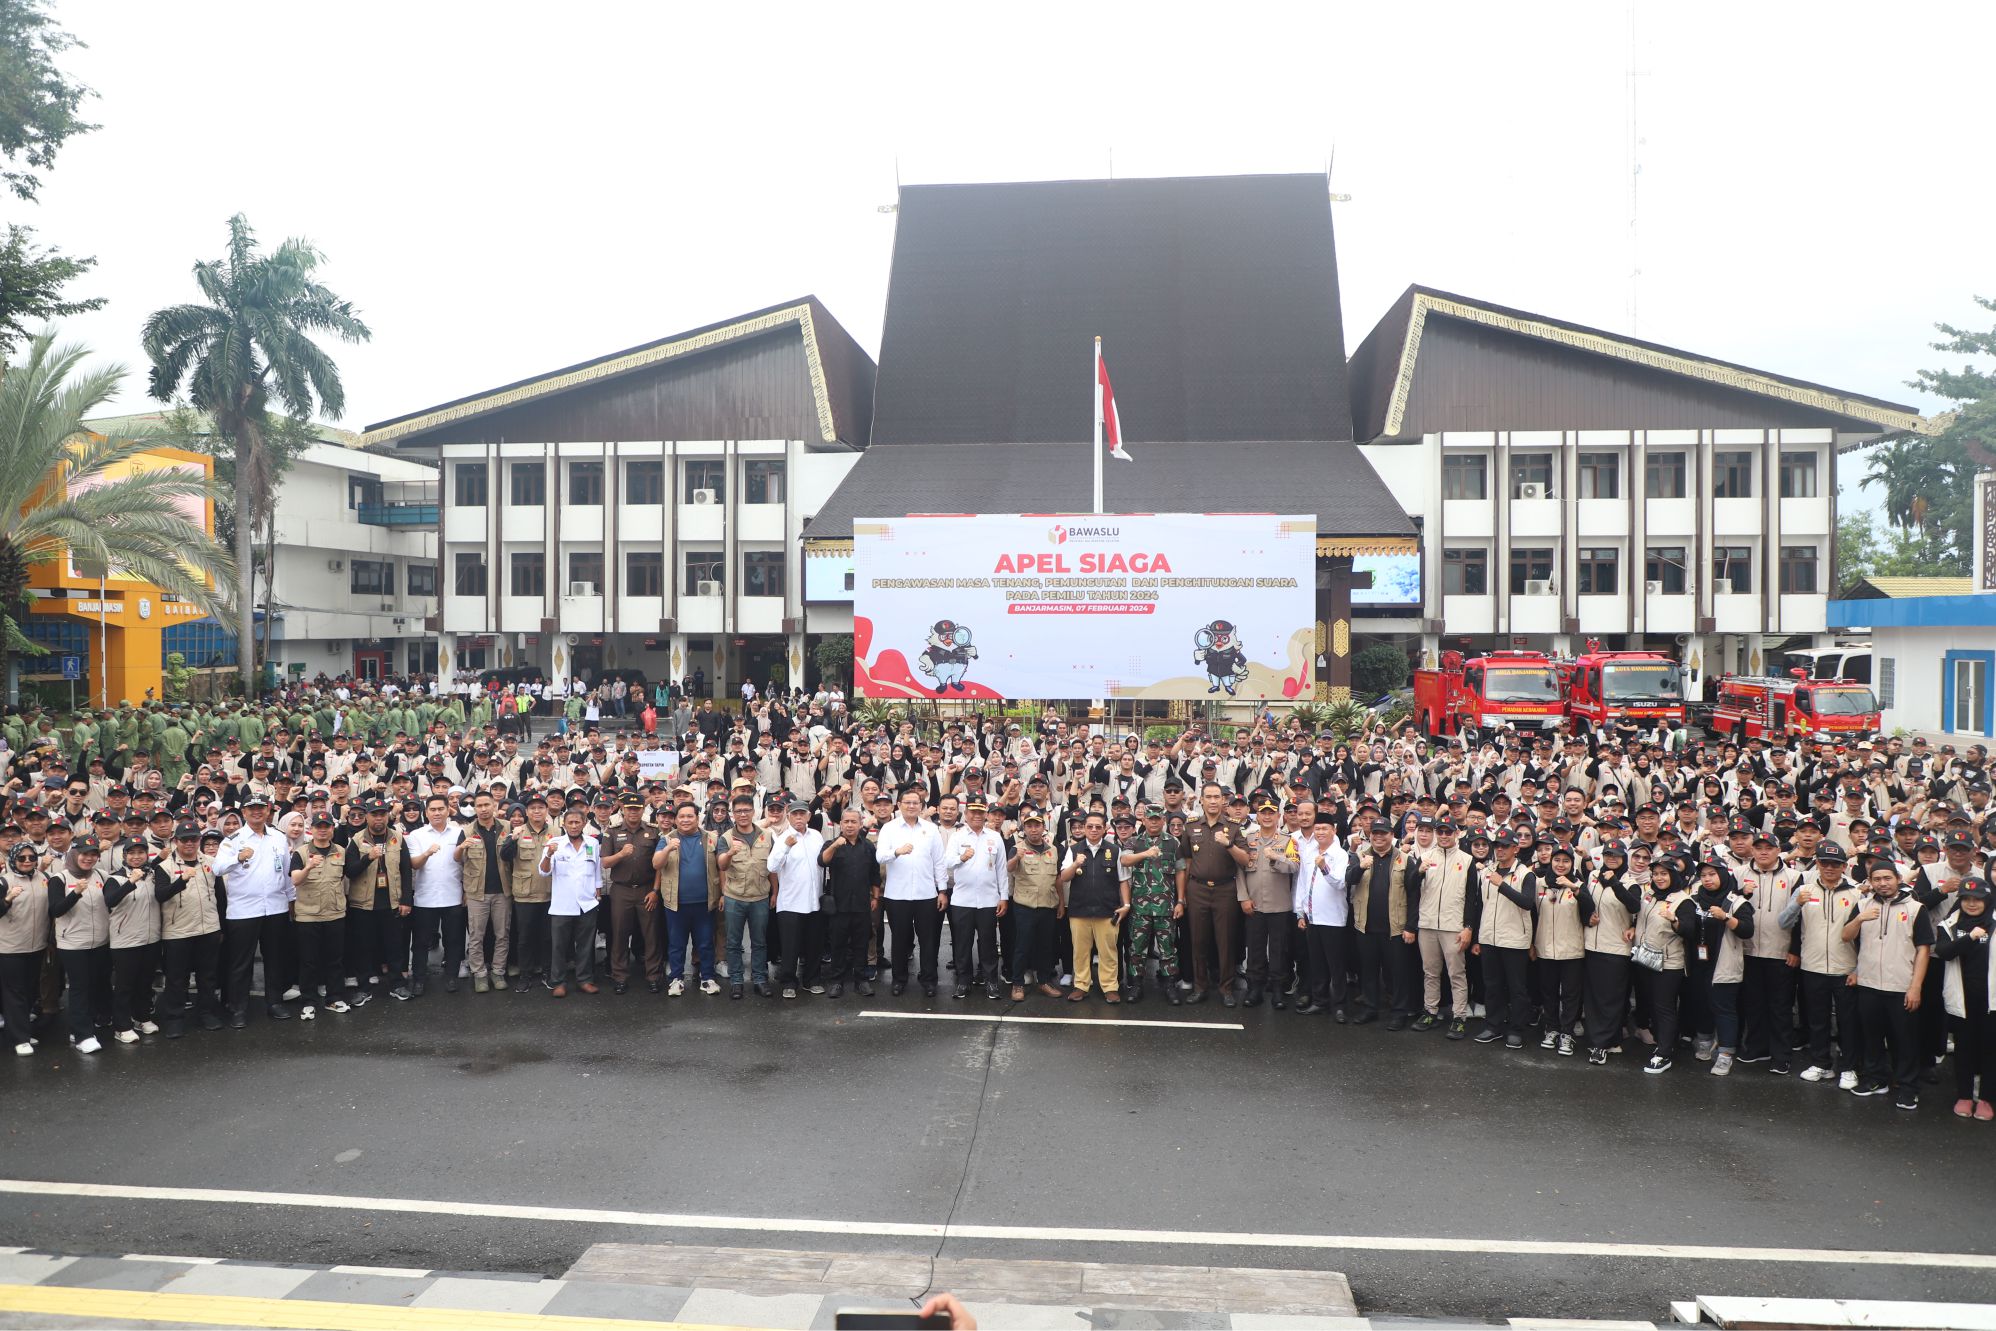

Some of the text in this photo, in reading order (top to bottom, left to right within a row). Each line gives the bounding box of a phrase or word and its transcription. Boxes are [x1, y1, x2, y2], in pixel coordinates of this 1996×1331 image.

[1069, 527, 1120, 536] BAWASLU
[994, 552, 1172, 573] APEL SIAGA
[872, 577, 1298, 589] PENGAWASAN MASA TENANG, PEMUNGUTAN DAN PENGHITUNGAN SUARA
[1006, 590, 1159, 600] PADA PEMILU TAHUN 2024
[1014, 604, 1149, 613] BANJARMASIN, 07 FEBRUARI 2024
